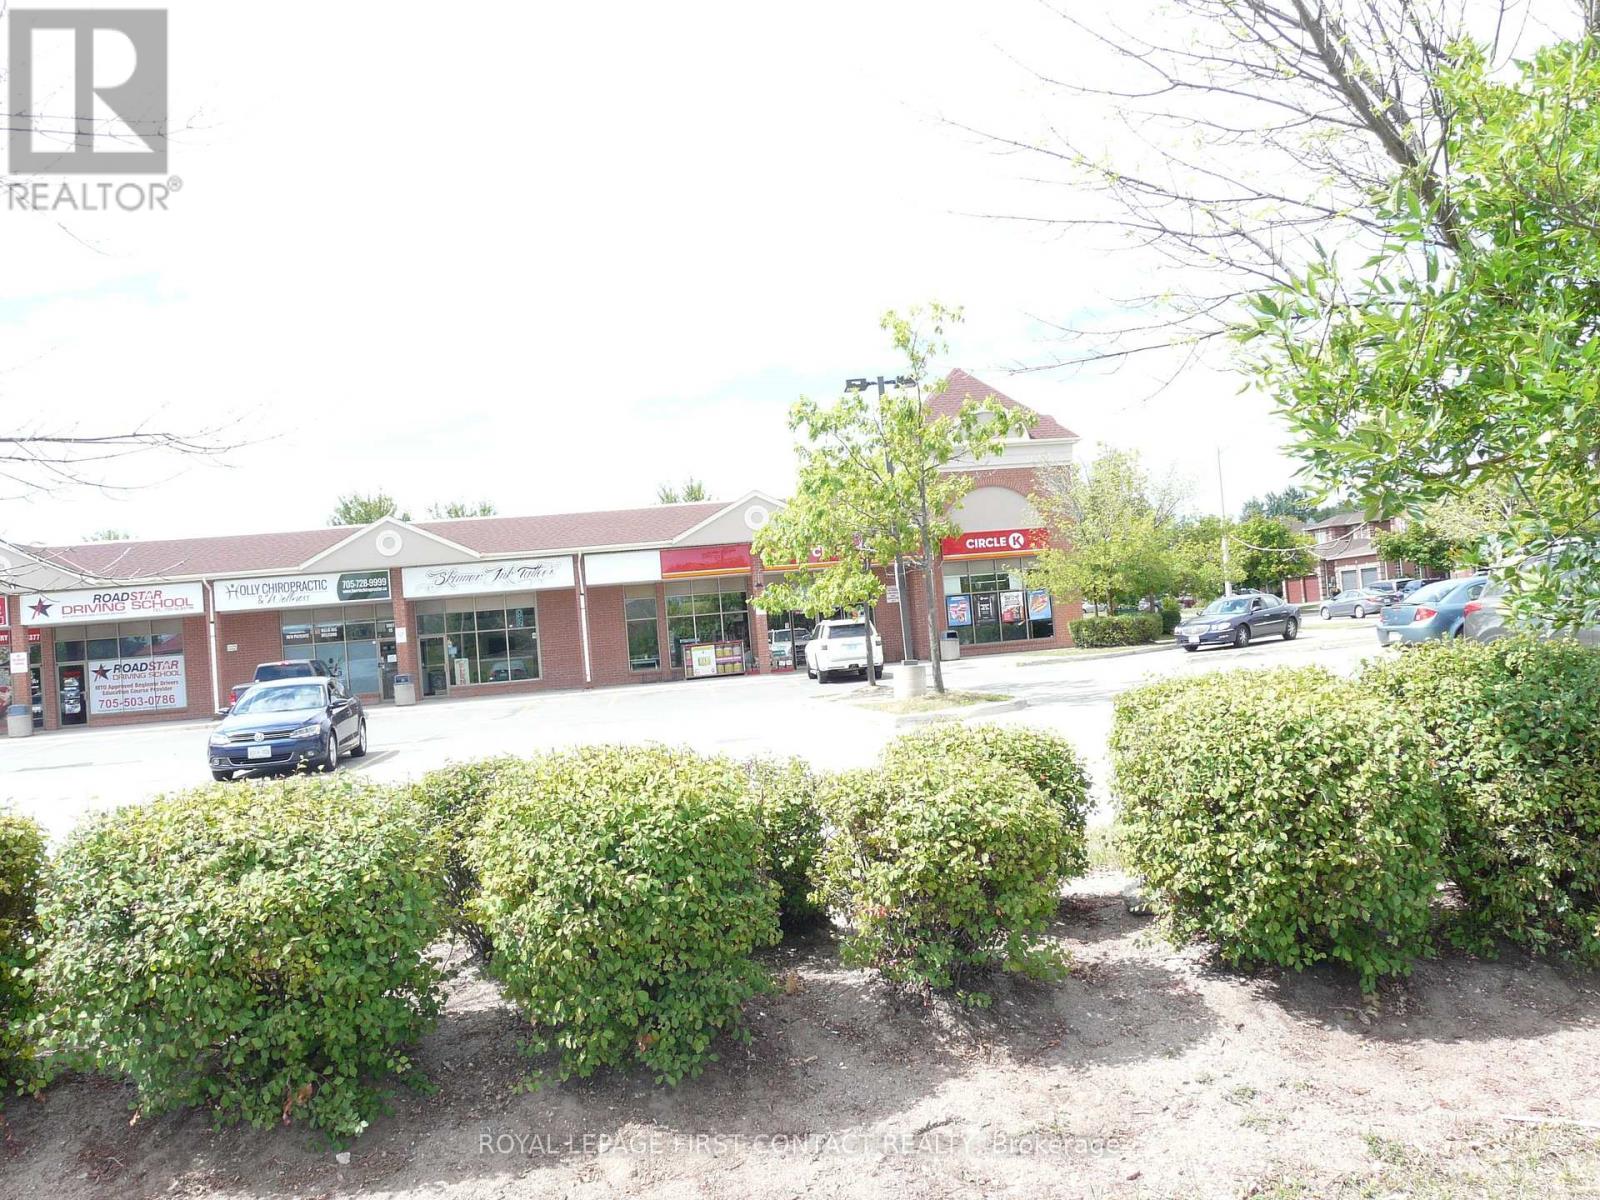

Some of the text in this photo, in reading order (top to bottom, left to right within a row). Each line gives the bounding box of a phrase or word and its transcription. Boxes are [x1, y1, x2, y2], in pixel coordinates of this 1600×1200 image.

[965, 532, 1025, 549] CIRCLE K
[261, 579, 328, 596] CHIROPRACTIC
[341, 577, 387, 589] 705-728-9999
[92, 590, 163, 604] ROADSTAR
[61, 602, 126, 615] DRIVING
[131, 597, 194, 610] SCHOOL
[113, 660, 179, 674] ROADSTAR
[112, 669, 182, 681] DRIVING SCHOOL
[98, 694, 176, 709] 705-503-0786
